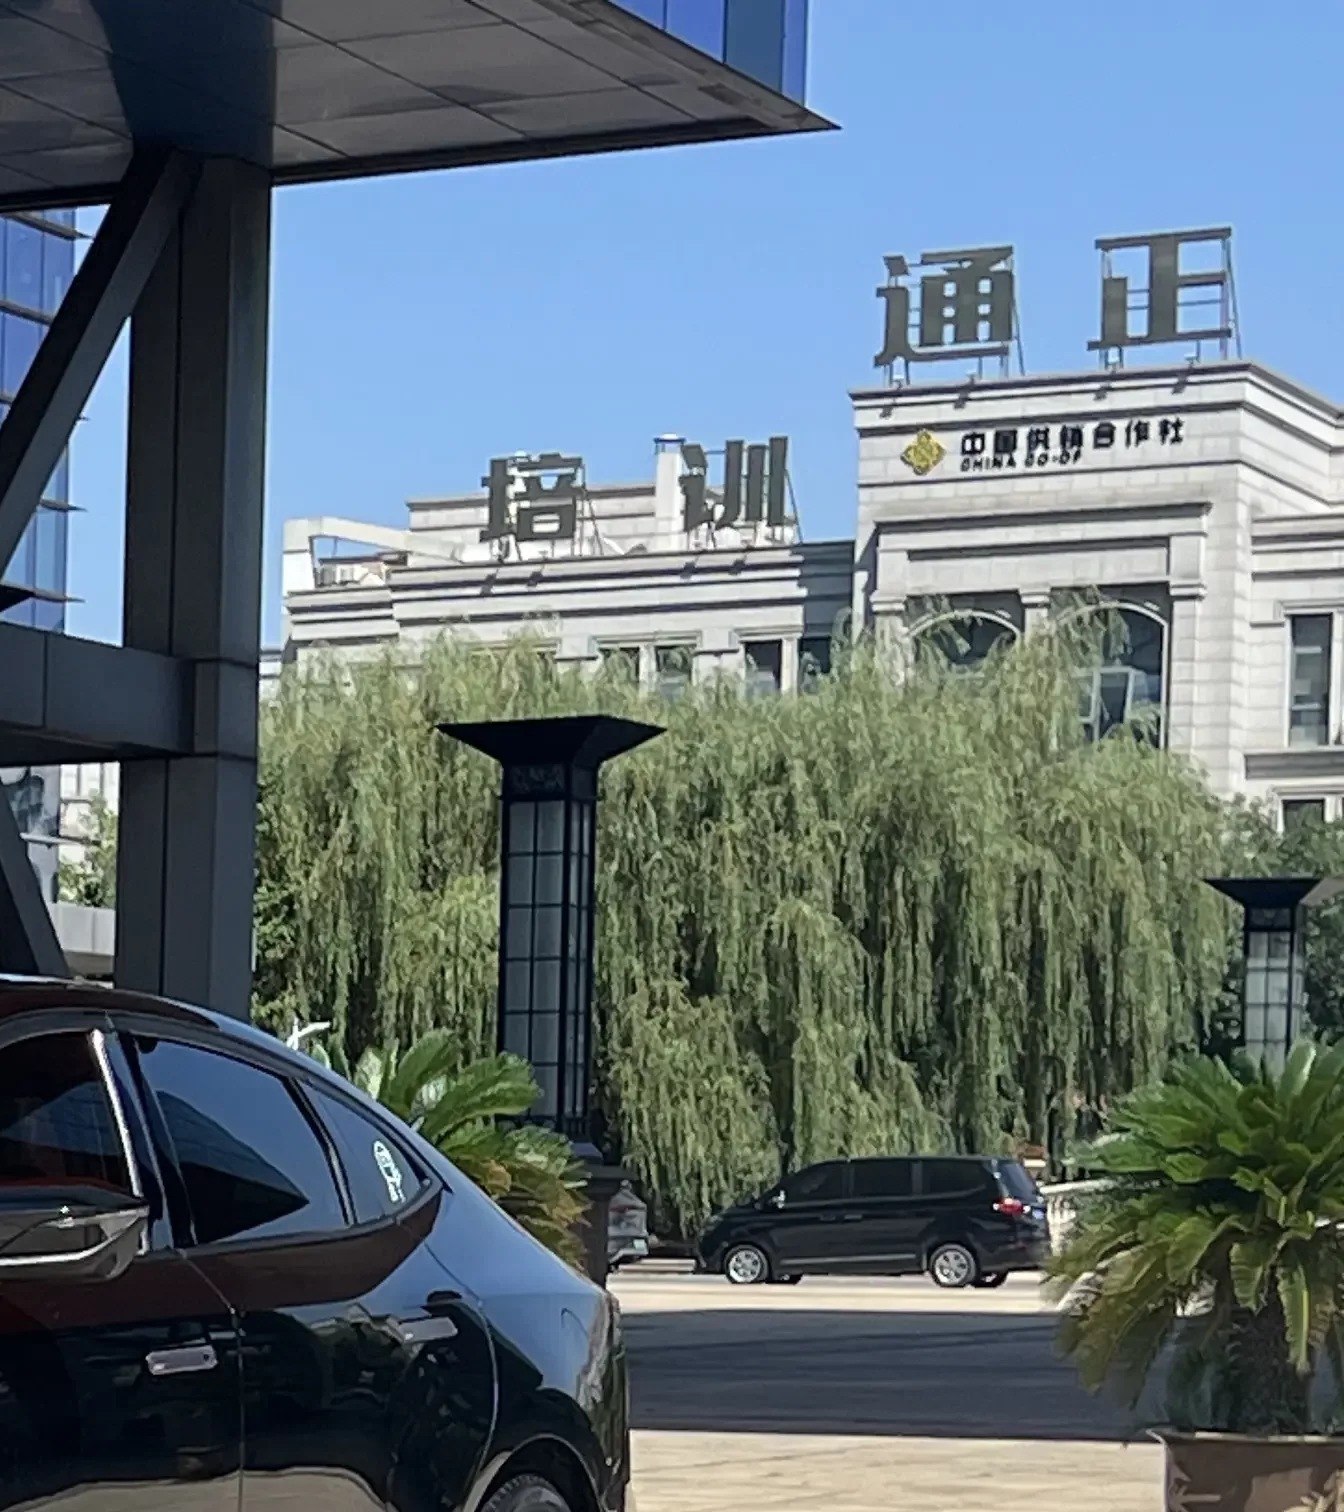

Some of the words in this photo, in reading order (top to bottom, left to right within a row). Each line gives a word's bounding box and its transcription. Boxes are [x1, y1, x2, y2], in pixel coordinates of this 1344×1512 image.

[873, 225, 1233, 369] 通正
[960, 417, 1185, 455] 中国供销合作社
[960, 454, 1017, 472] CHINA
[479, 435, 789, 543] 培训
